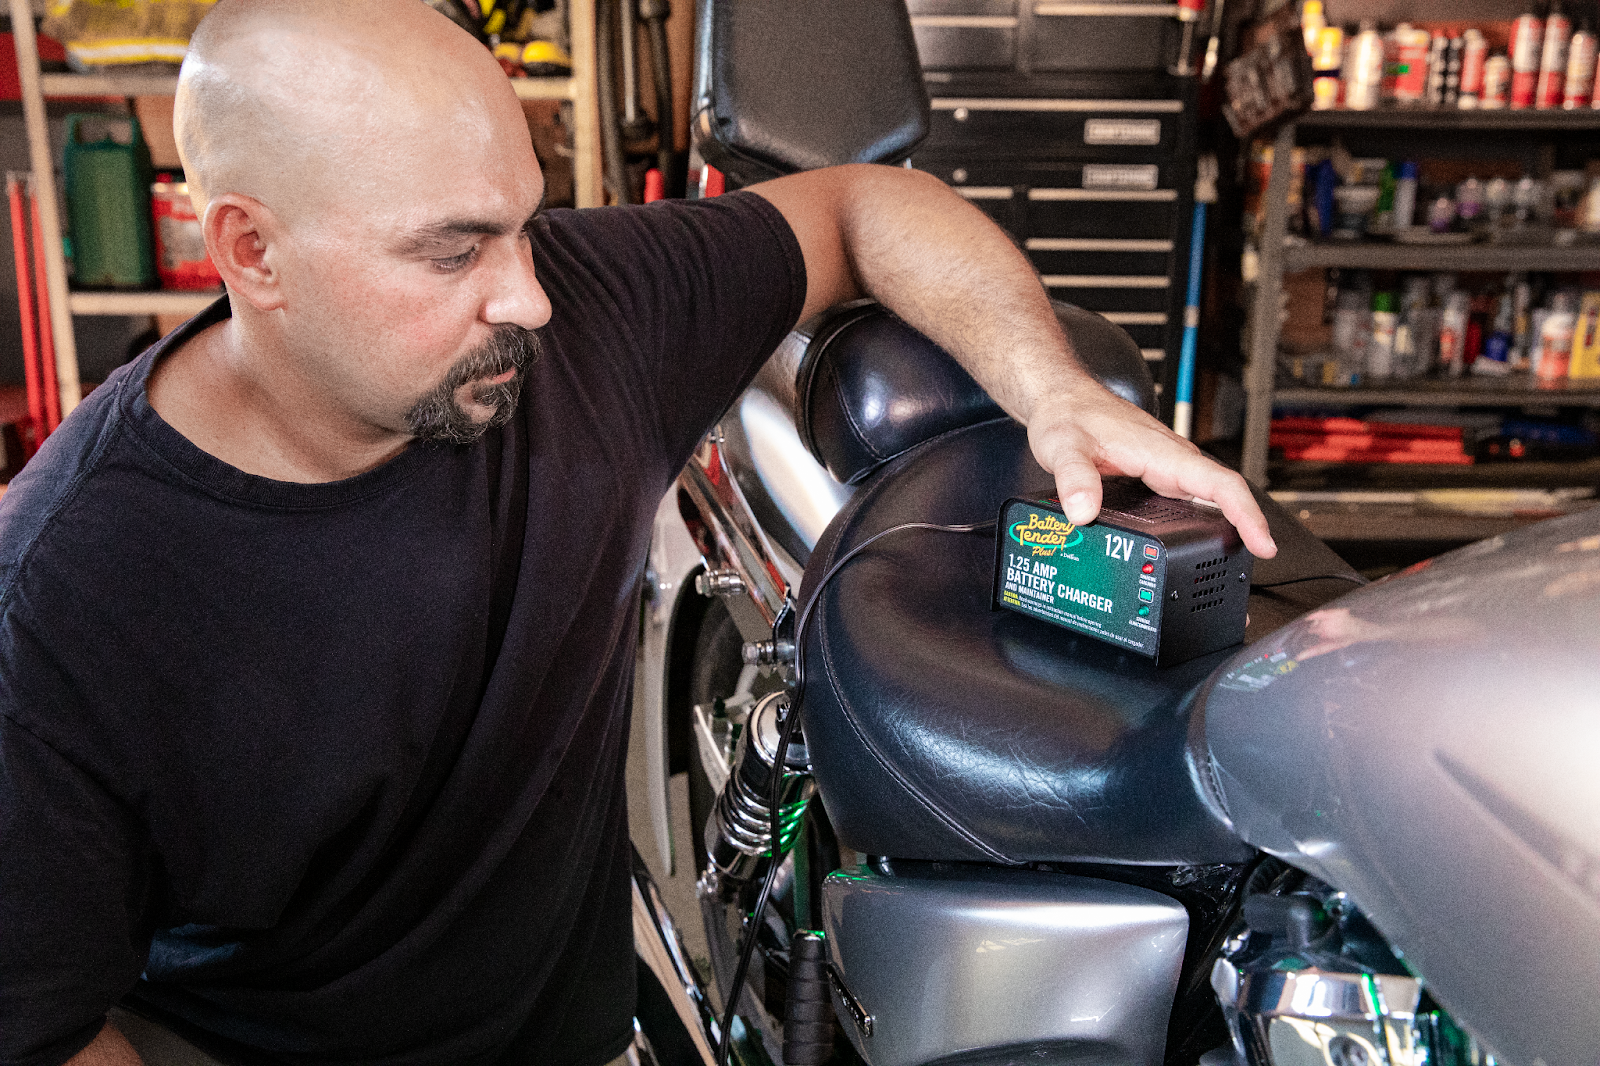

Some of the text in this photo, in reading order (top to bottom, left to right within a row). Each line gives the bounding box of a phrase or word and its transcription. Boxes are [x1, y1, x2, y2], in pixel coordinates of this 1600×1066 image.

[1027, 513, 1076, 535] Battery
[1016, 525, 1067, 551] Tender
[1105, 533, 1134, 562] 12V
[1032, 546, 1057, 557] Plus!
[1009, 553, 1058, 580] 1.25 AMP
[1004, 581, 1018, 592] AND
[1018, 585, 1055, 604] MAINTAINER
[1006, 567, 1113, 614] BATTERY CHARGER
